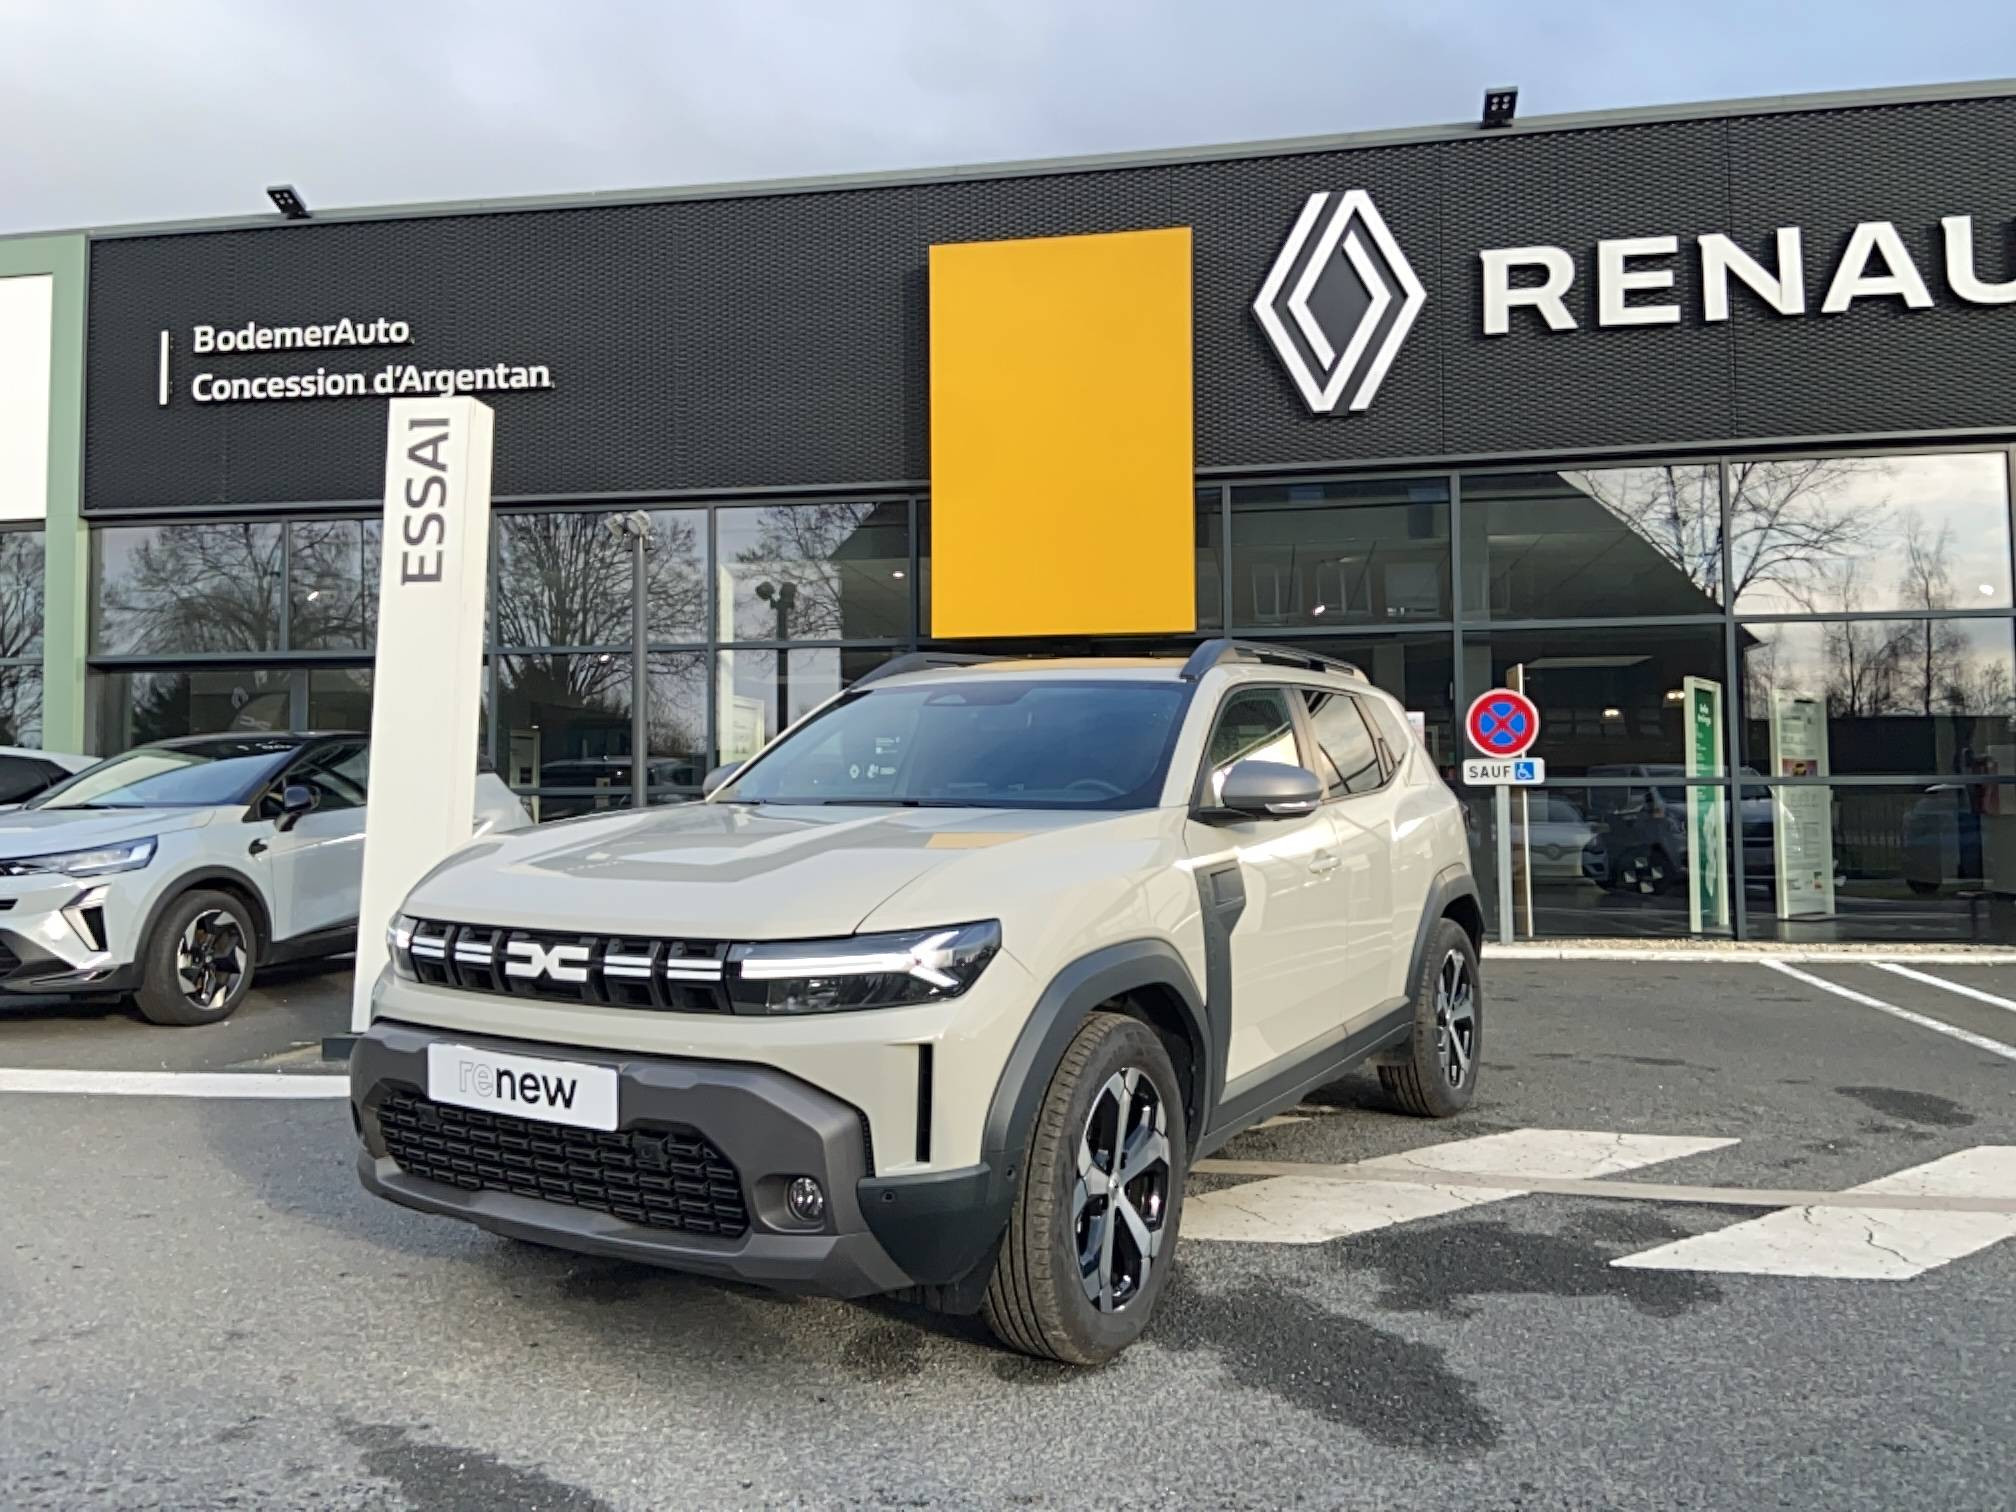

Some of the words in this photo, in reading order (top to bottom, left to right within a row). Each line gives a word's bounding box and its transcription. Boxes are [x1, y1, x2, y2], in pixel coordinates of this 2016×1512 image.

[1480, 214, 2016, 335] RENAU
[193, 317, 410, 354] BodemerAuto
[191, 367, 367, 402] Concession
[373, 362, 552, 398] d'Argentan
[401, 417, 450, 586] ESSAI
[1469, 765, 1511, 779] SAUF
[459, 1059, 577, 1110] renew
